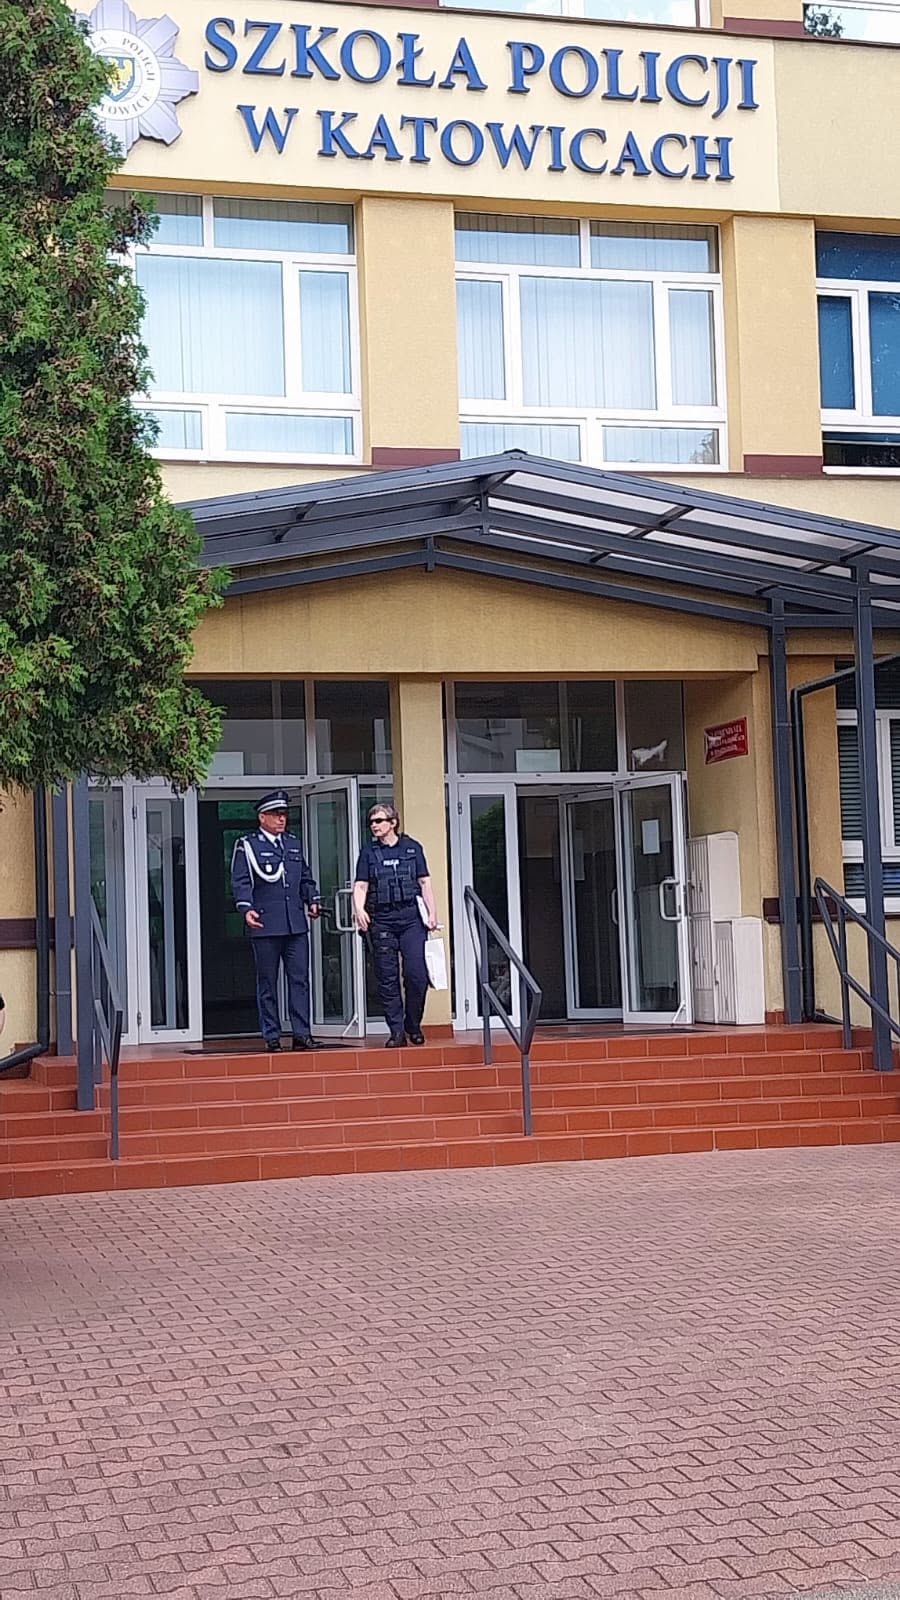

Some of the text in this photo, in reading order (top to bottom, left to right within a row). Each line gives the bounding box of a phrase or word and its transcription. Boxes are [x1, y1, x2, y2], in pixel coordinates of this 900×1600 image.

[122, 38, 155, 81] POLICJI
[205, 17, 760, 119] SZKOŁA POLICJI
[236, 104, 735, 182] W KATOWICACH
